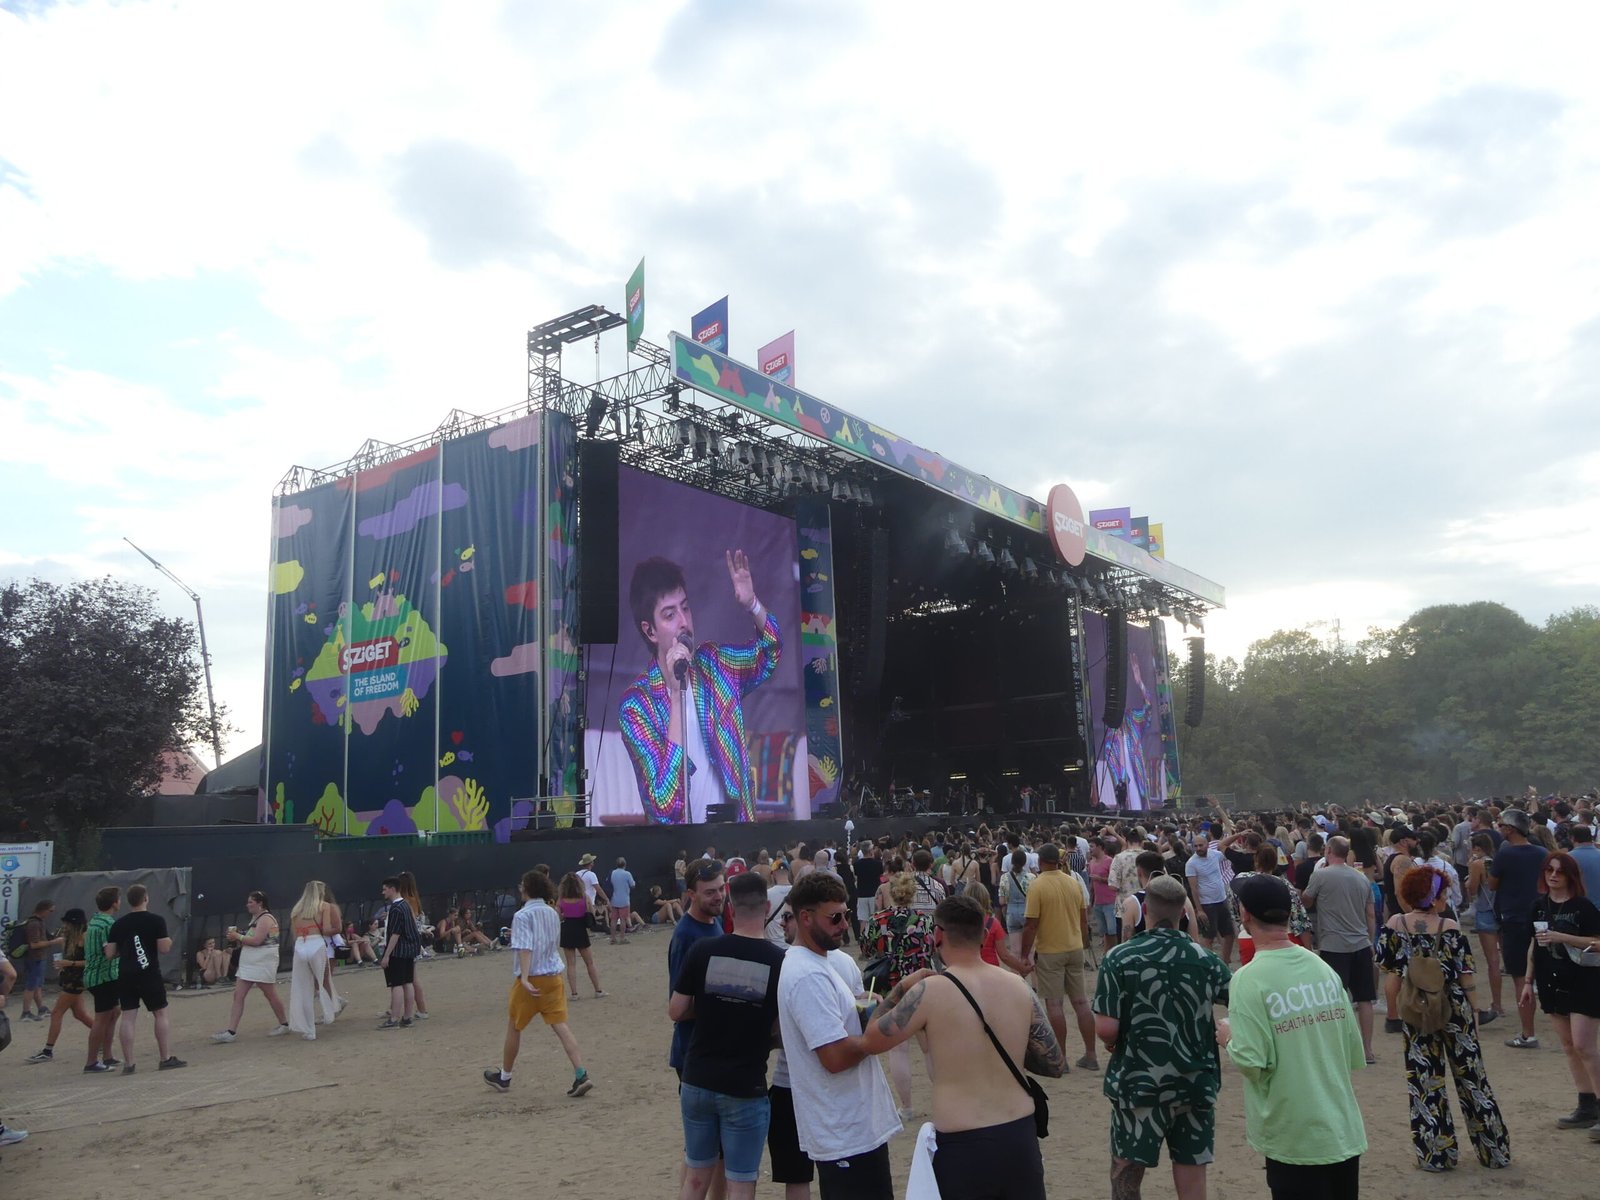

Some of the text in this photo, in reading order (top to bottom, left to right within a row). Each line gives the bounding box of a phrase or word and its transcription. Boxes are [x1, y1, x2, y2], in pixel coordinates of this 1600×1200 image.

[354, 677, 369, 688] THE
[354, 681, 399, 697] OF FREEDOM
[1274, 1015, 1306, 1035] HEALTH
